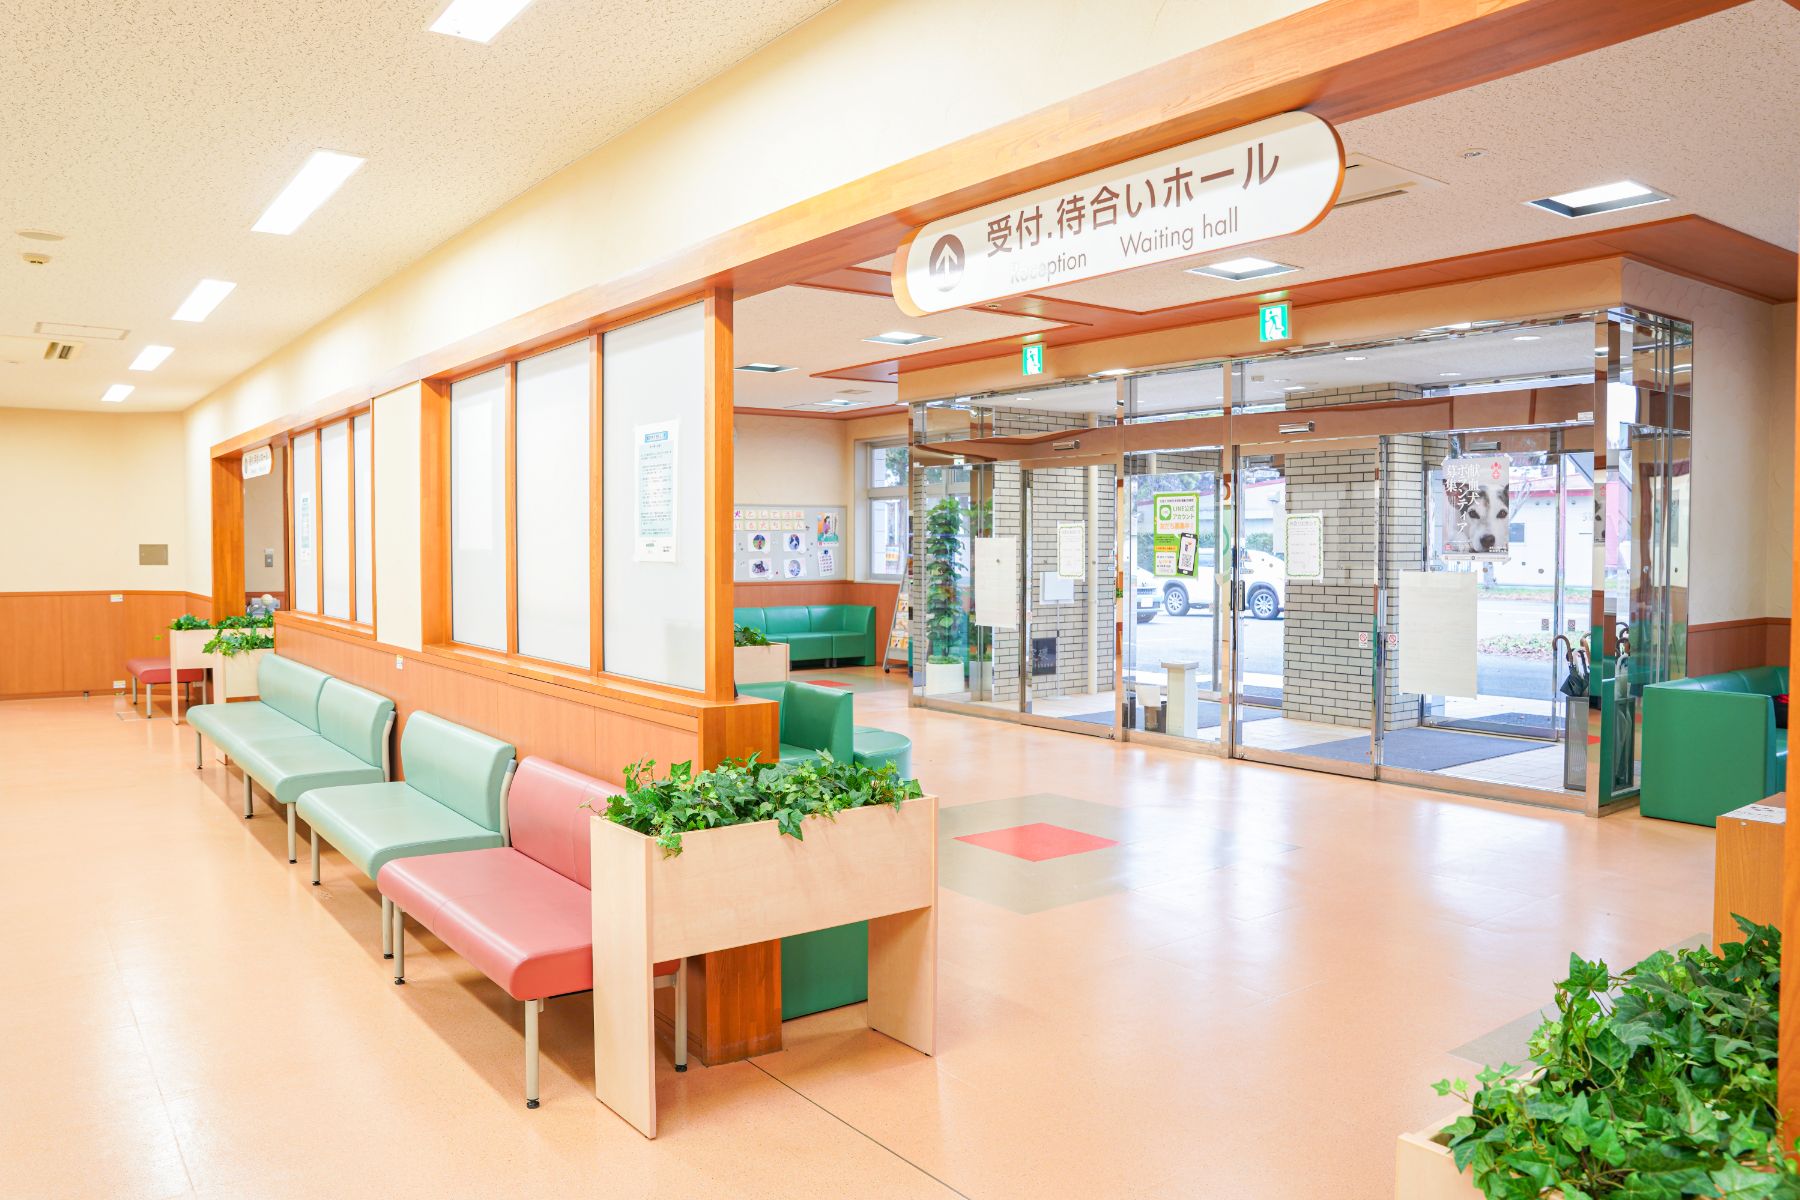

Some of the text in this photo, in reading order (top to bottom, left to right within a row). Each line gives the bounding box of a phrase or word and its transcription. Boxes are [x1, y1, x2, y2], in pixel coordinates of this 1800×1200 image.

[1120, 224, 1194, 257] Waiting
[1203, 206, 1239, 239] hall
[1446, 463, 1458, 493] 募集
[1467, 463, 1481, 506] 献血犬
